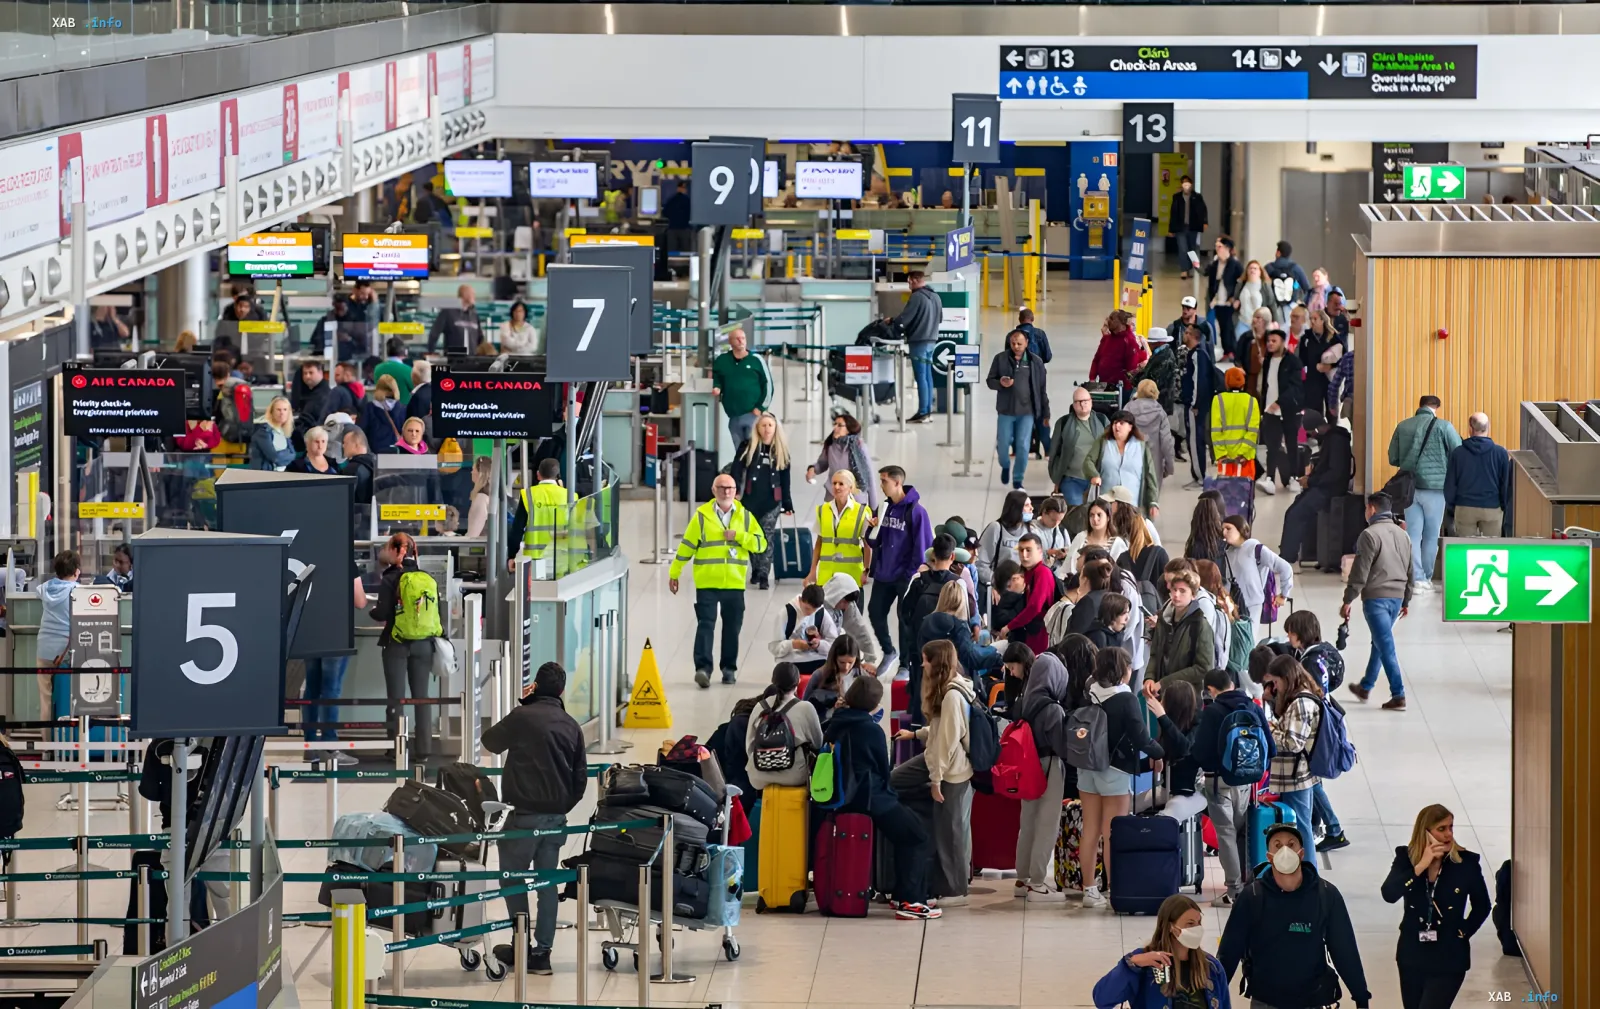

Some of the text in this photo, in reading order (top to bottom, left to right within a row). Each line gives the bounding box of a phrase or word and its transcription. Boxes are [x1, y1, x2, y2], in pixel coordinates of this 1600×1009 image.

[1050, 49, 1075, 68] 13
[1109, 59, 1198, 71] Check-in Areas
[1231, 49, 1257, 68] 14
[1371, 73, 1457, 85] Oversized Baggage
[1371, 83, 1399, 93] Check
[1410, 83, 1432, 93] Area
[1434, 83, 1446, 93] 14
[960, 116, 993, 148] 11
[1128, 113, 1167, 143] 13
[709, 165, 735, 205] 9
[572, 298, 606, 352] 7
[91, 377, 176, 387] AIR CANADA
[459, 380, 542, 390] AIR CANADA
[72, 399, 132, 409] Priority check-in
[440, 402, 499, 411] Priority check-in
[179, 592, 239, 685] 5
